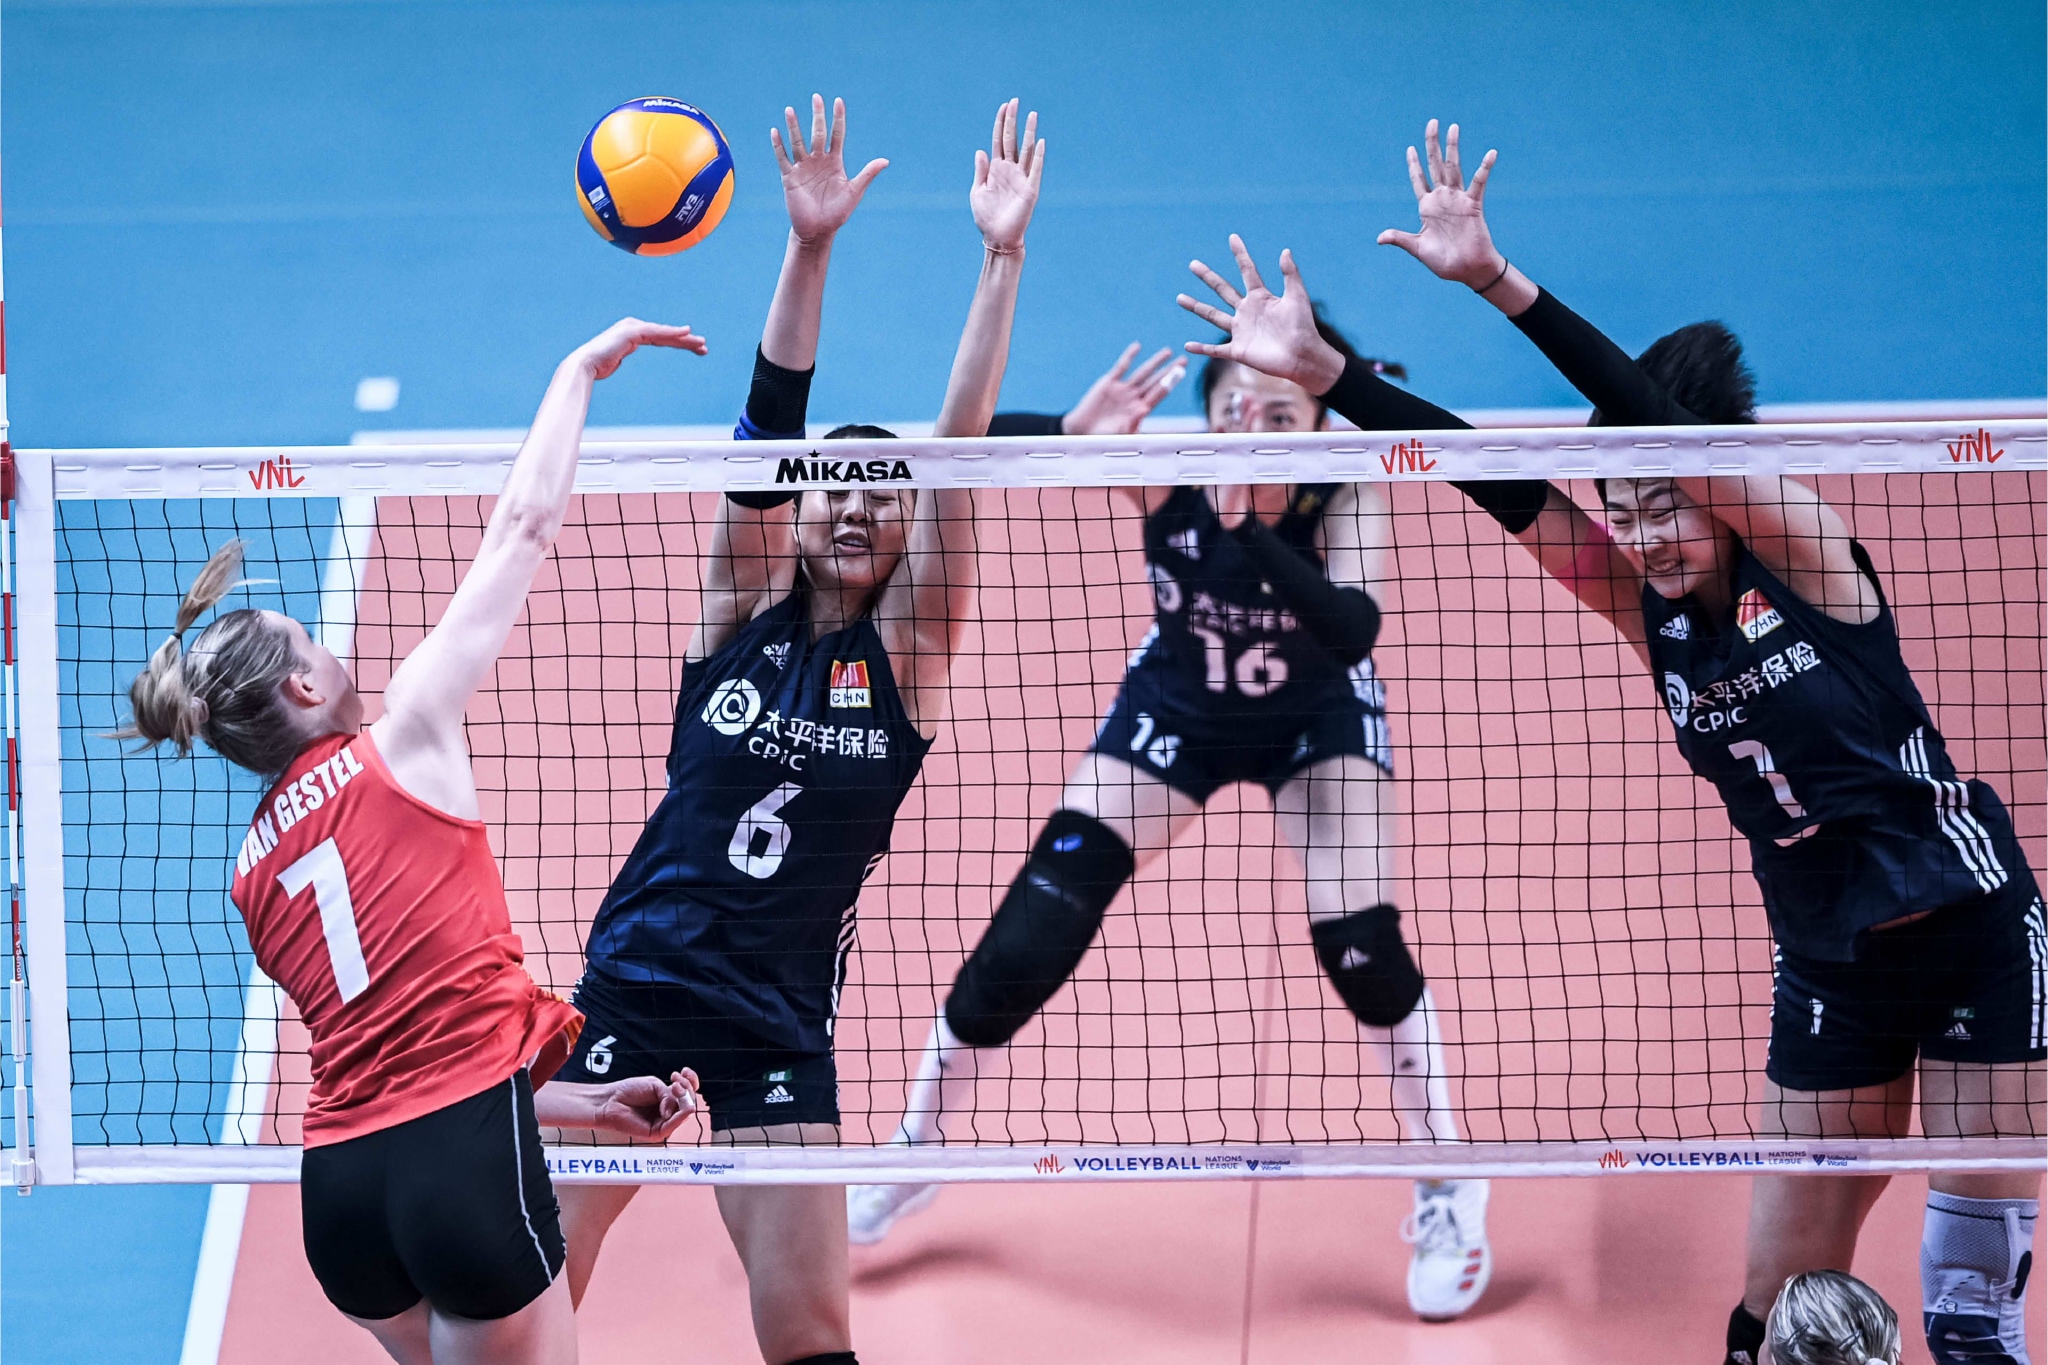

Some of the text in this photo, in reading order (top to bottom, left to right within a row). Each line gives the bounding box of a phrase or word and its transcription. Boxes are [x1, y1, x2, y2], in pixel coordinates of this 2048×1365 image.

[1379, 438, 1437, 474] VNL
[1947, 428, 2004, 464] VNL
[248, 455, 305, 490] VNL
[775, 449, 913, 483] MIKASA
[1750, 611, 1779, 635] CHN
[1188, 626, 1289, 698] 16
[832, 692, 865, 704] CHN
[757, 709, 889, 759] 太平洋保险
[1693, 706, 1748, 733] CPIC
[748, 736, 806, 771] CPIC
[236, 746, 365, 878] VAN GESTEL
[728, 781, 804, 879] 6
[276, 835, 370, 1006] 7
[586, 1035, 617, 1075] 6
[547, 1159, 643, 1174] LLEYBALL
[1033, 1154, 1202, 1174] VNL VOLLEYBALL
[1205, 1162, 1239, 1170] LEAGUE
[1598, 1149, 1764, 1169] VNL VOLLEYBALL
[1768, 1157, 1802, 1165] LEAGUE
